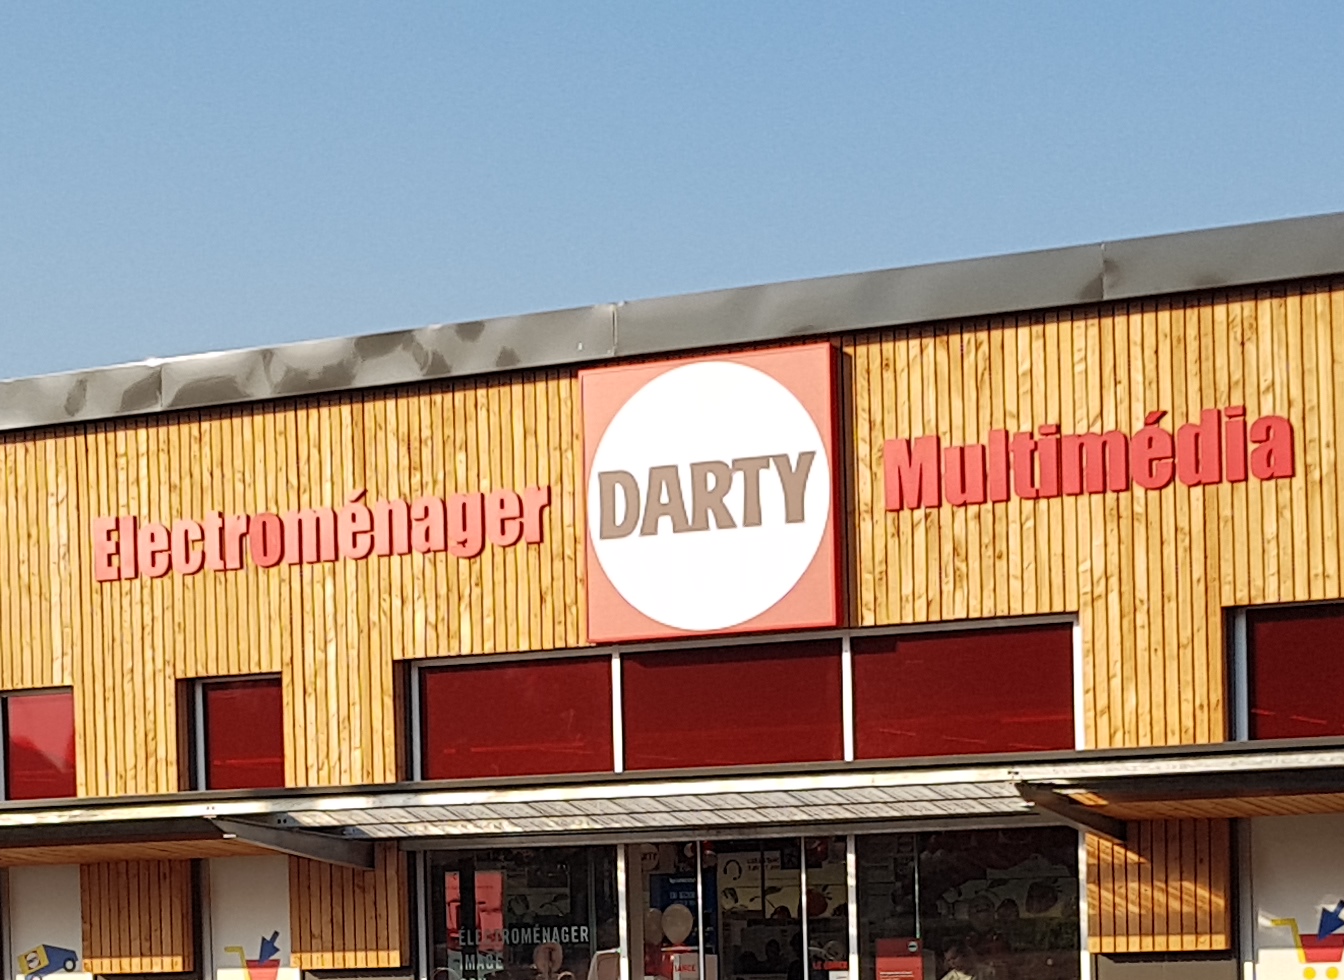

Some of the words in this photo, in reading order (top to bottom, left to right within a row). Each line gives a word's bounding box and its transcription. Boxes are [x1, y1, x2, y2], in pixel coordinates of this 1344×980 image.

[598, 451, 816, 540] DARTY
[883, 405, 1295, 511] Multimédia
[93, 485, 551, 582] Electroménager
